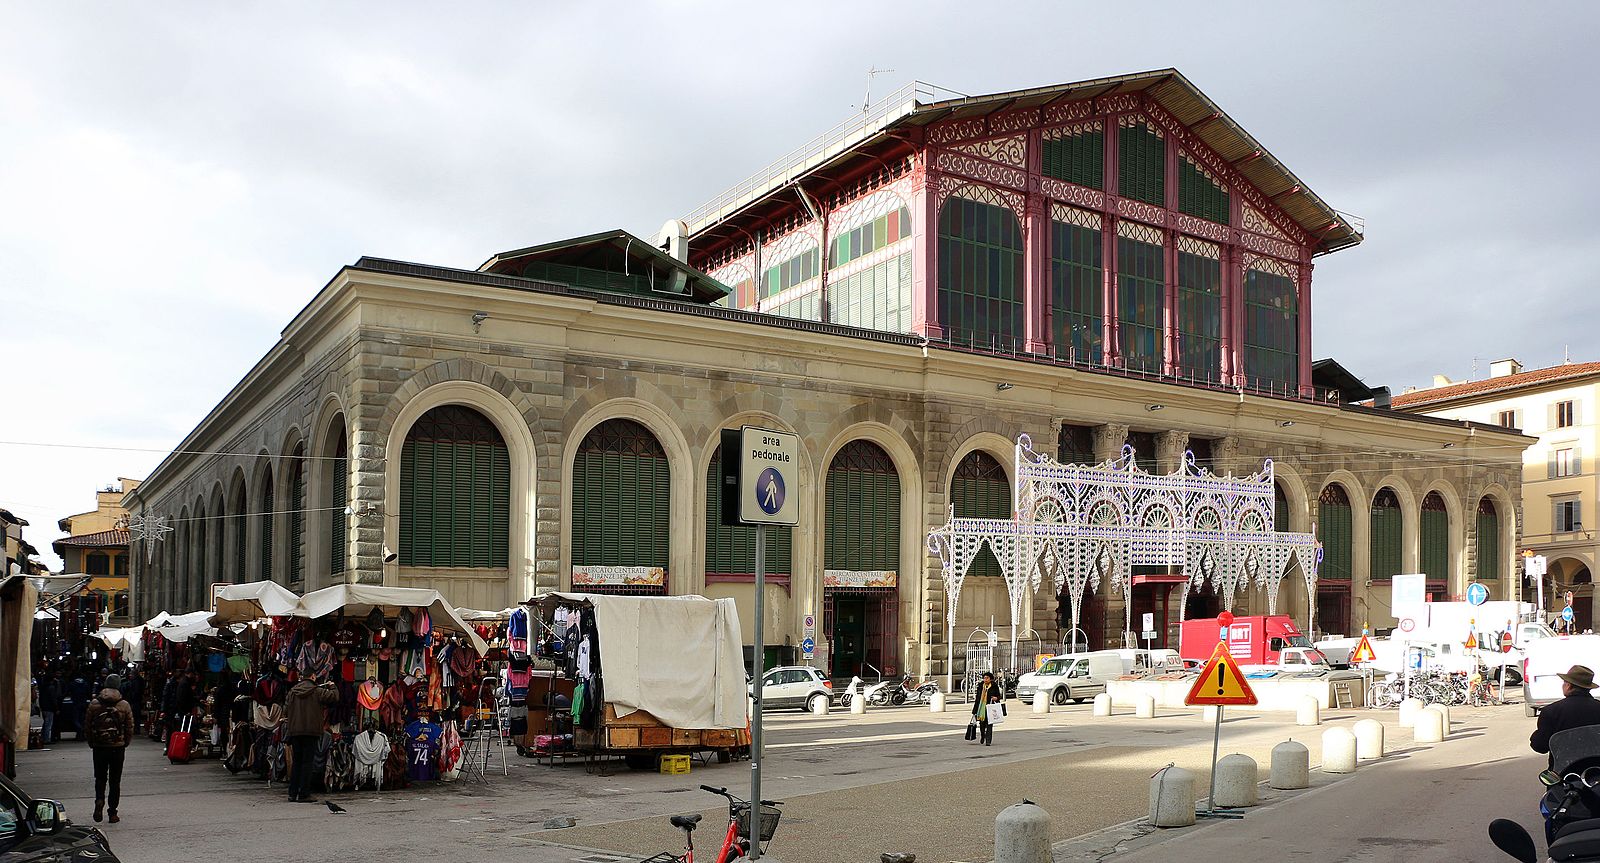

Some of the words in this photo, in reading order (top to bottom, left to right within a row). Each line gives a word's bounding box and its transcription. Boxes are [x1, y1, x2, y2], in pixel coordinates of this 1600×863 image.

[763, 436, 780, 446] area
[752, 449, 790, 463] pedonale
[1231, 628, 1250, 640] BRT
[414, 748, 428, 766] 74
